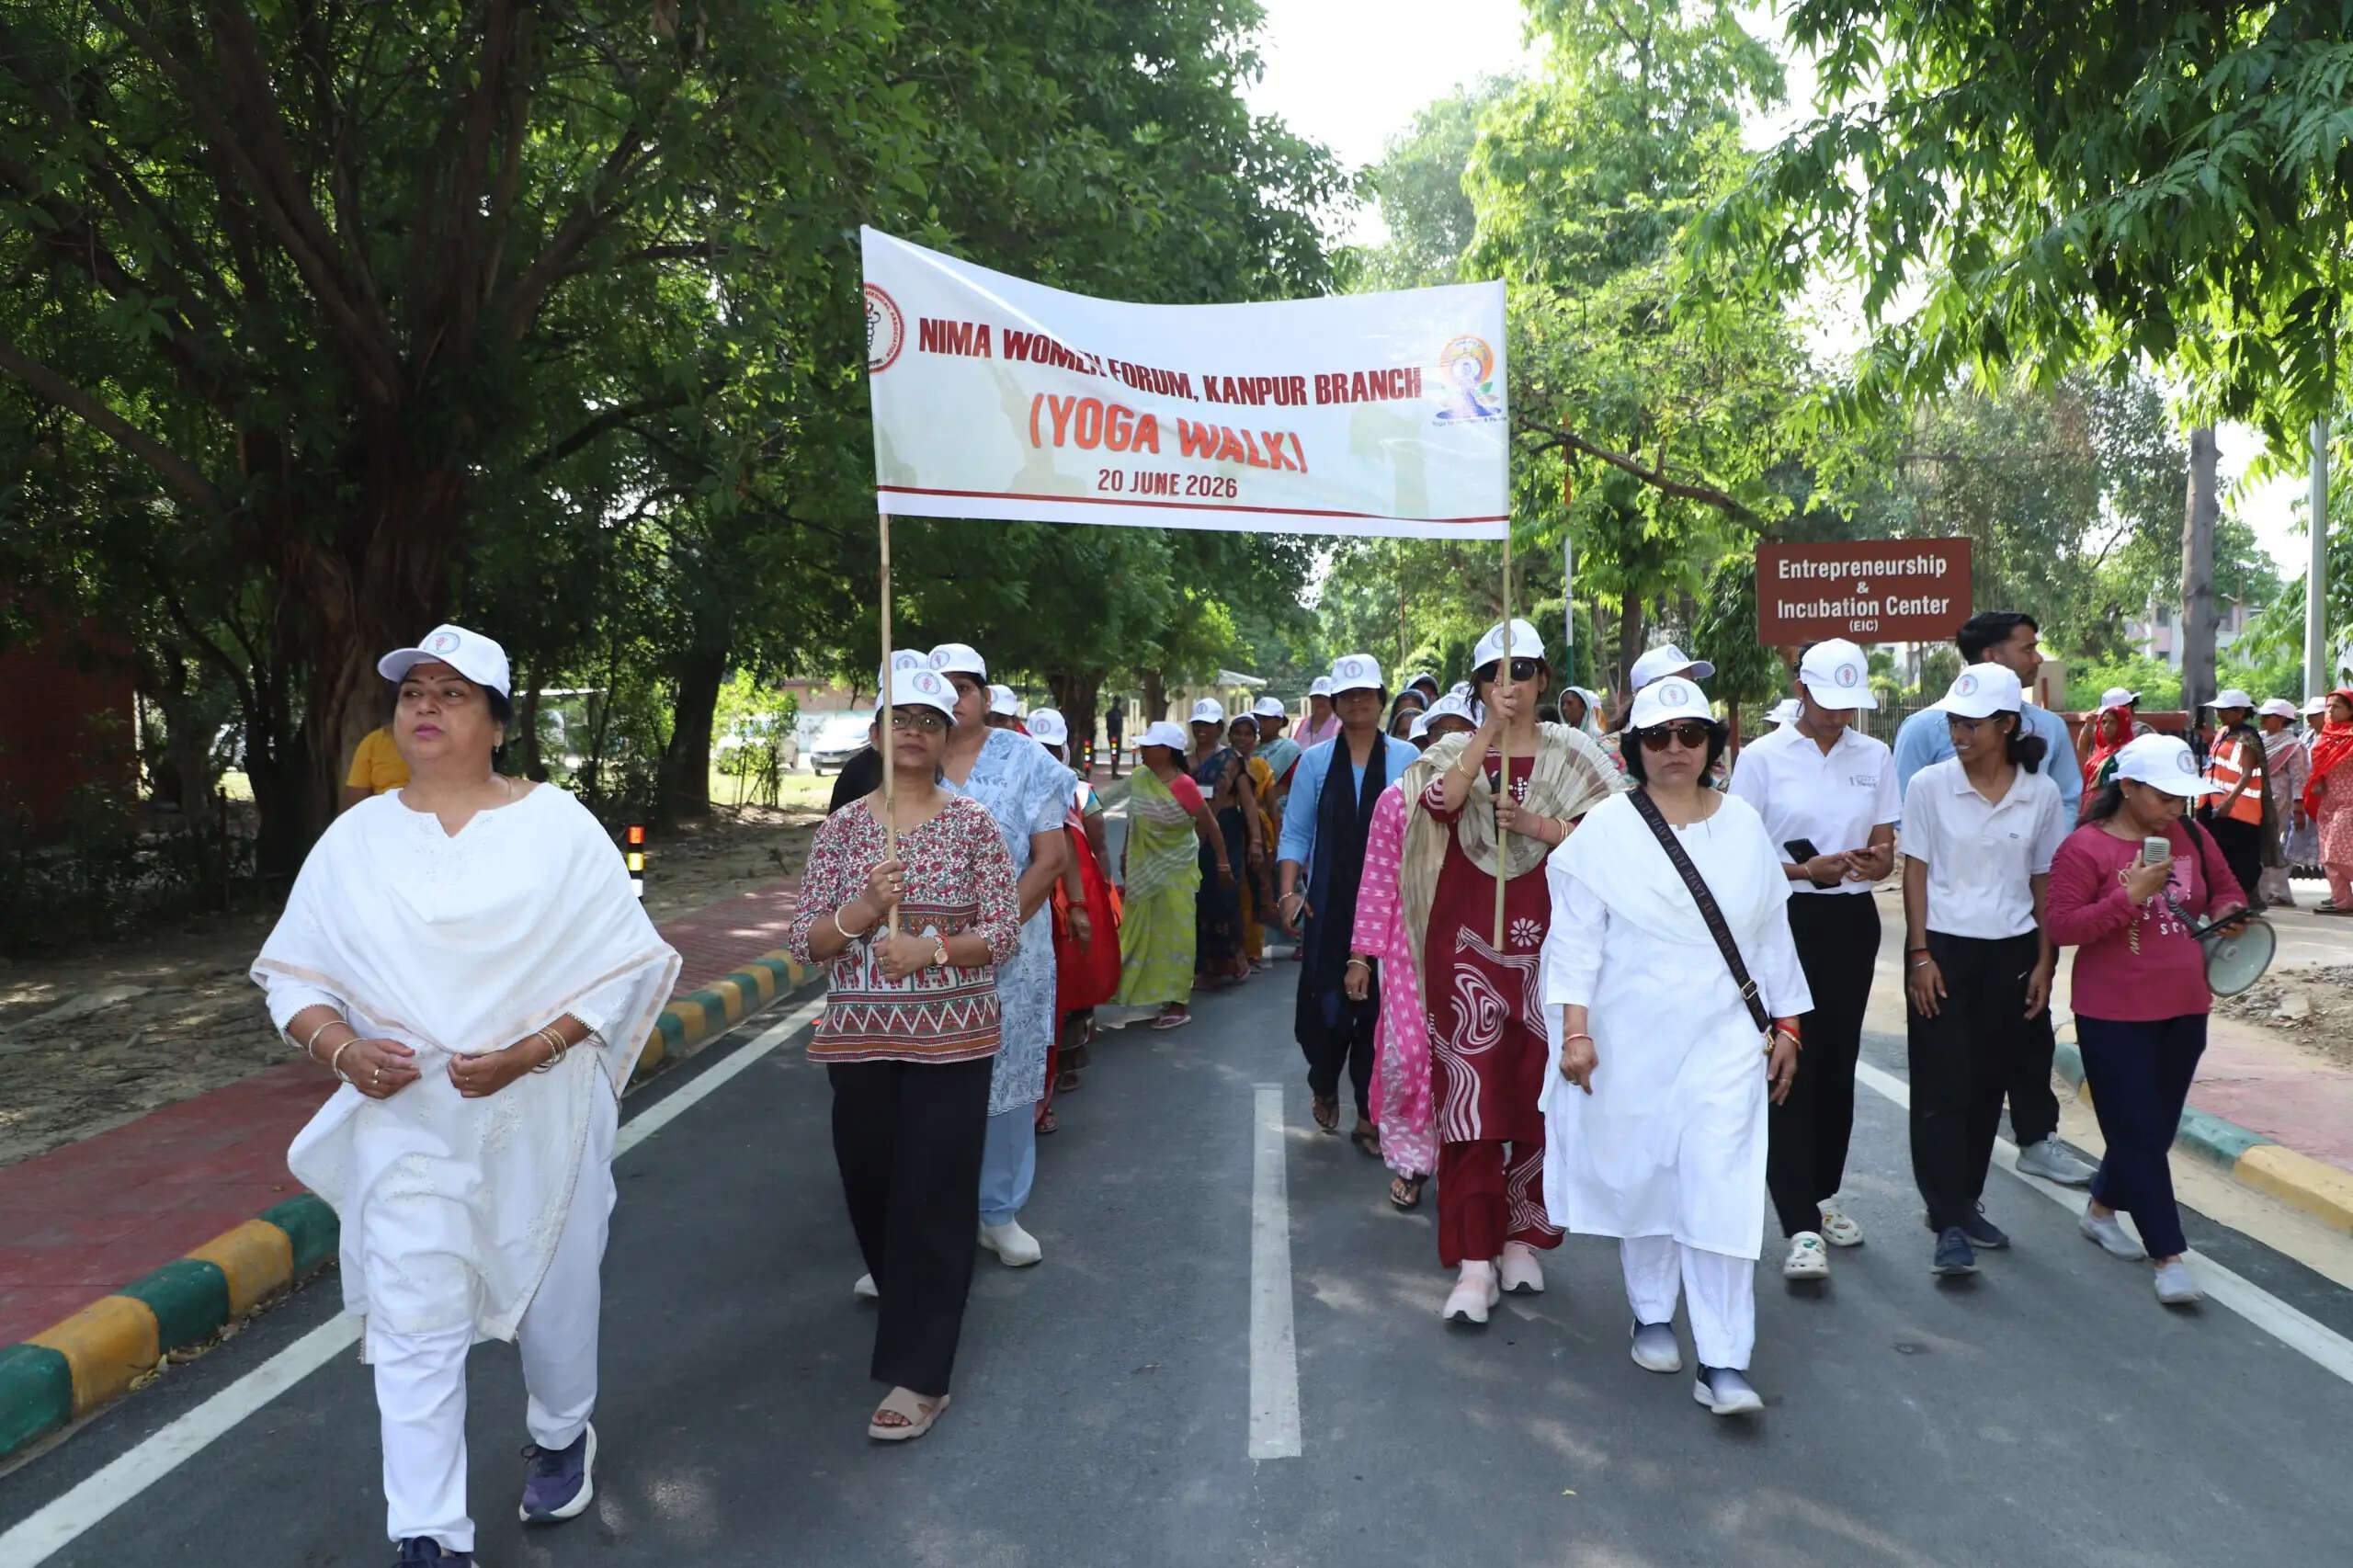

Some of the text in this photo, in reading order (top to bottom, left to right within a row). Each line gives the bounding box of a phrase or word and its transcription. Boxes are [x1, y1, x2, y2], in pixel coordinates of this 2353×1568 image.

[919, 317, 1422, 405] NIMA WOMEN FORUM, KANPUR BRANCH
[1029, 392, 1308, 473] (YOGA WALK)
[1097, 469, 1238, 498] 20 JUNE 2026
[1779, 554, 1948, 581] Entrepreneurship
[1856, 581, 1870, 594] &
[1778, 596, 1949, 619] Incubation Center
[1849, 619, 1879, 633] (EIC)
